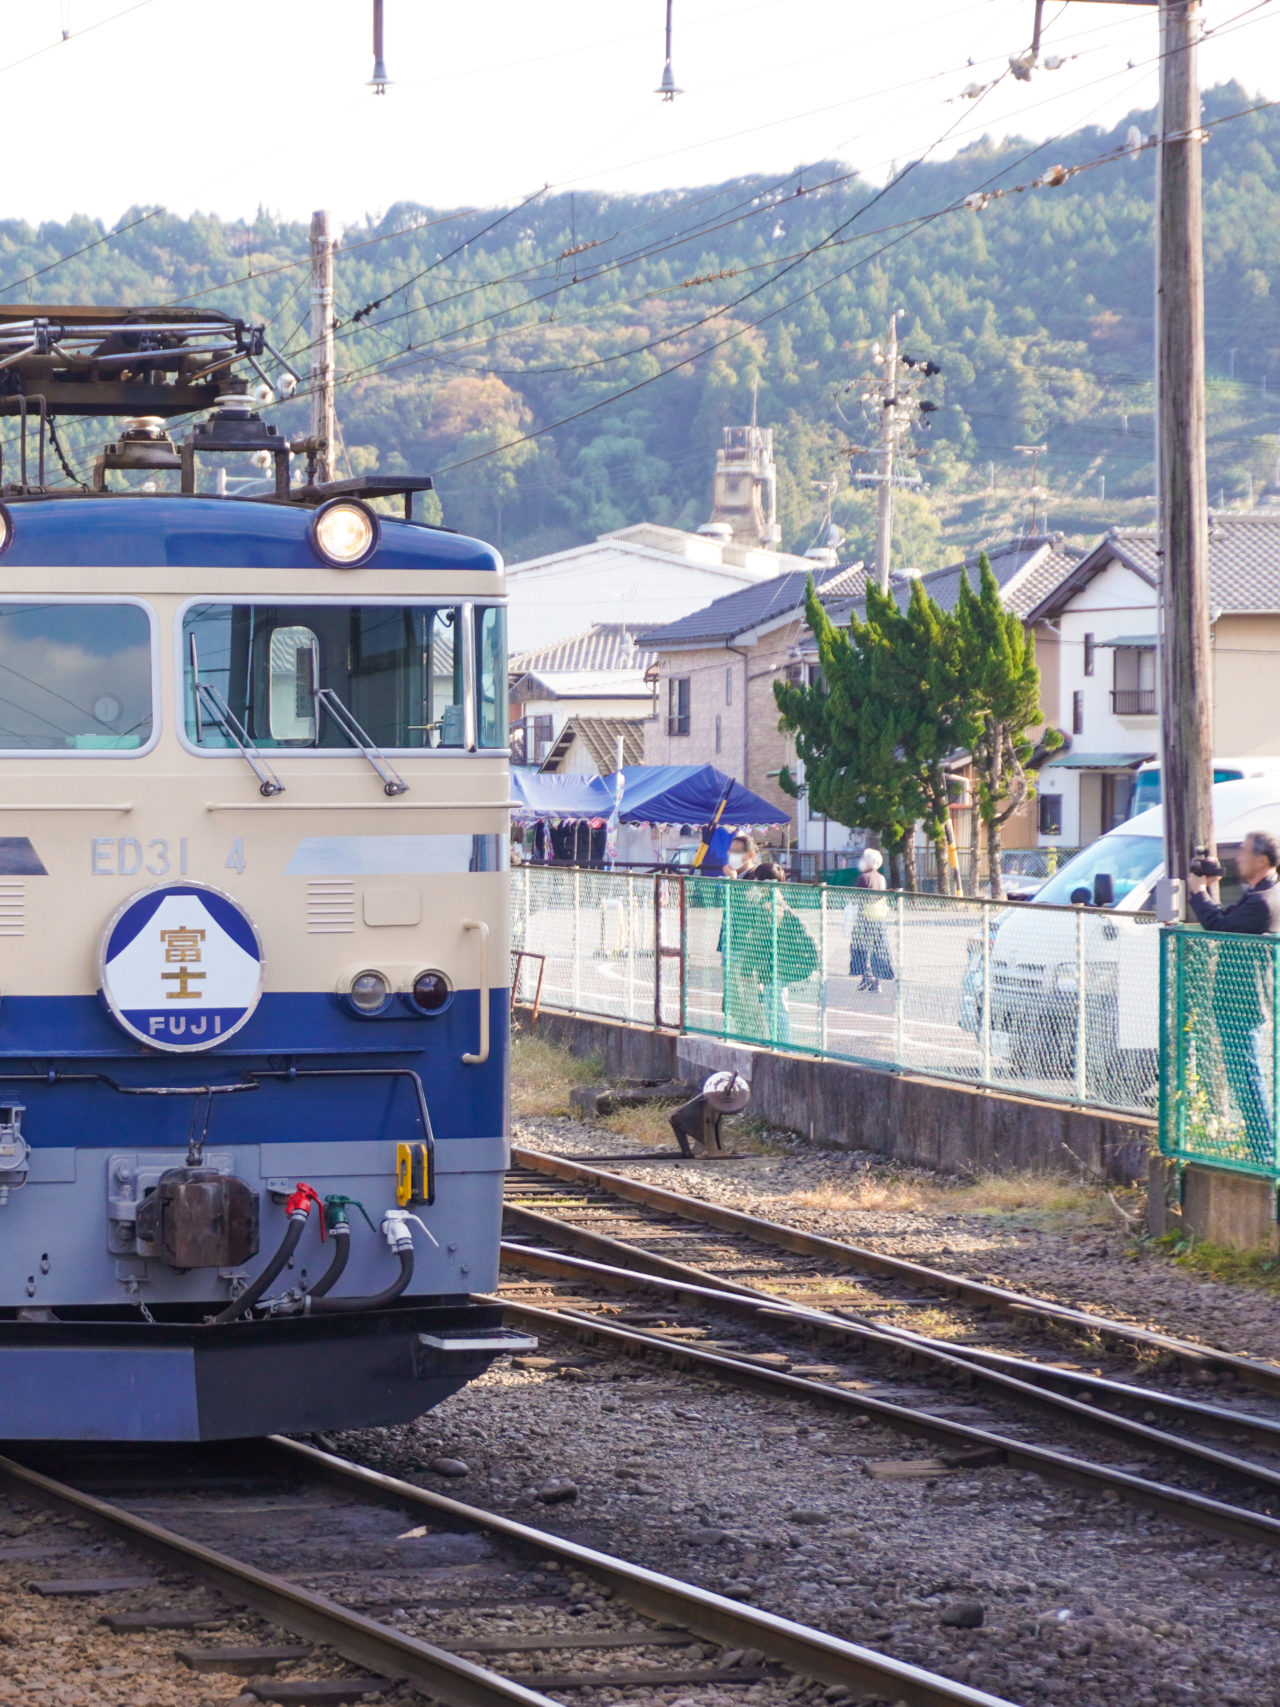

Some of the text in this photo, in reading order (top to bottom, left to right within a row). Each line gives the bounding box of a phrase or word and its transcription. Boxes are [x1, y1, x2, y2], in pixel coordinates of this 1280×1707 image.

[91, 837, 247, 875] ED31 4
[160, 926, 207, 999] 富士
[149, 1016, 222, 1035] FUJI
